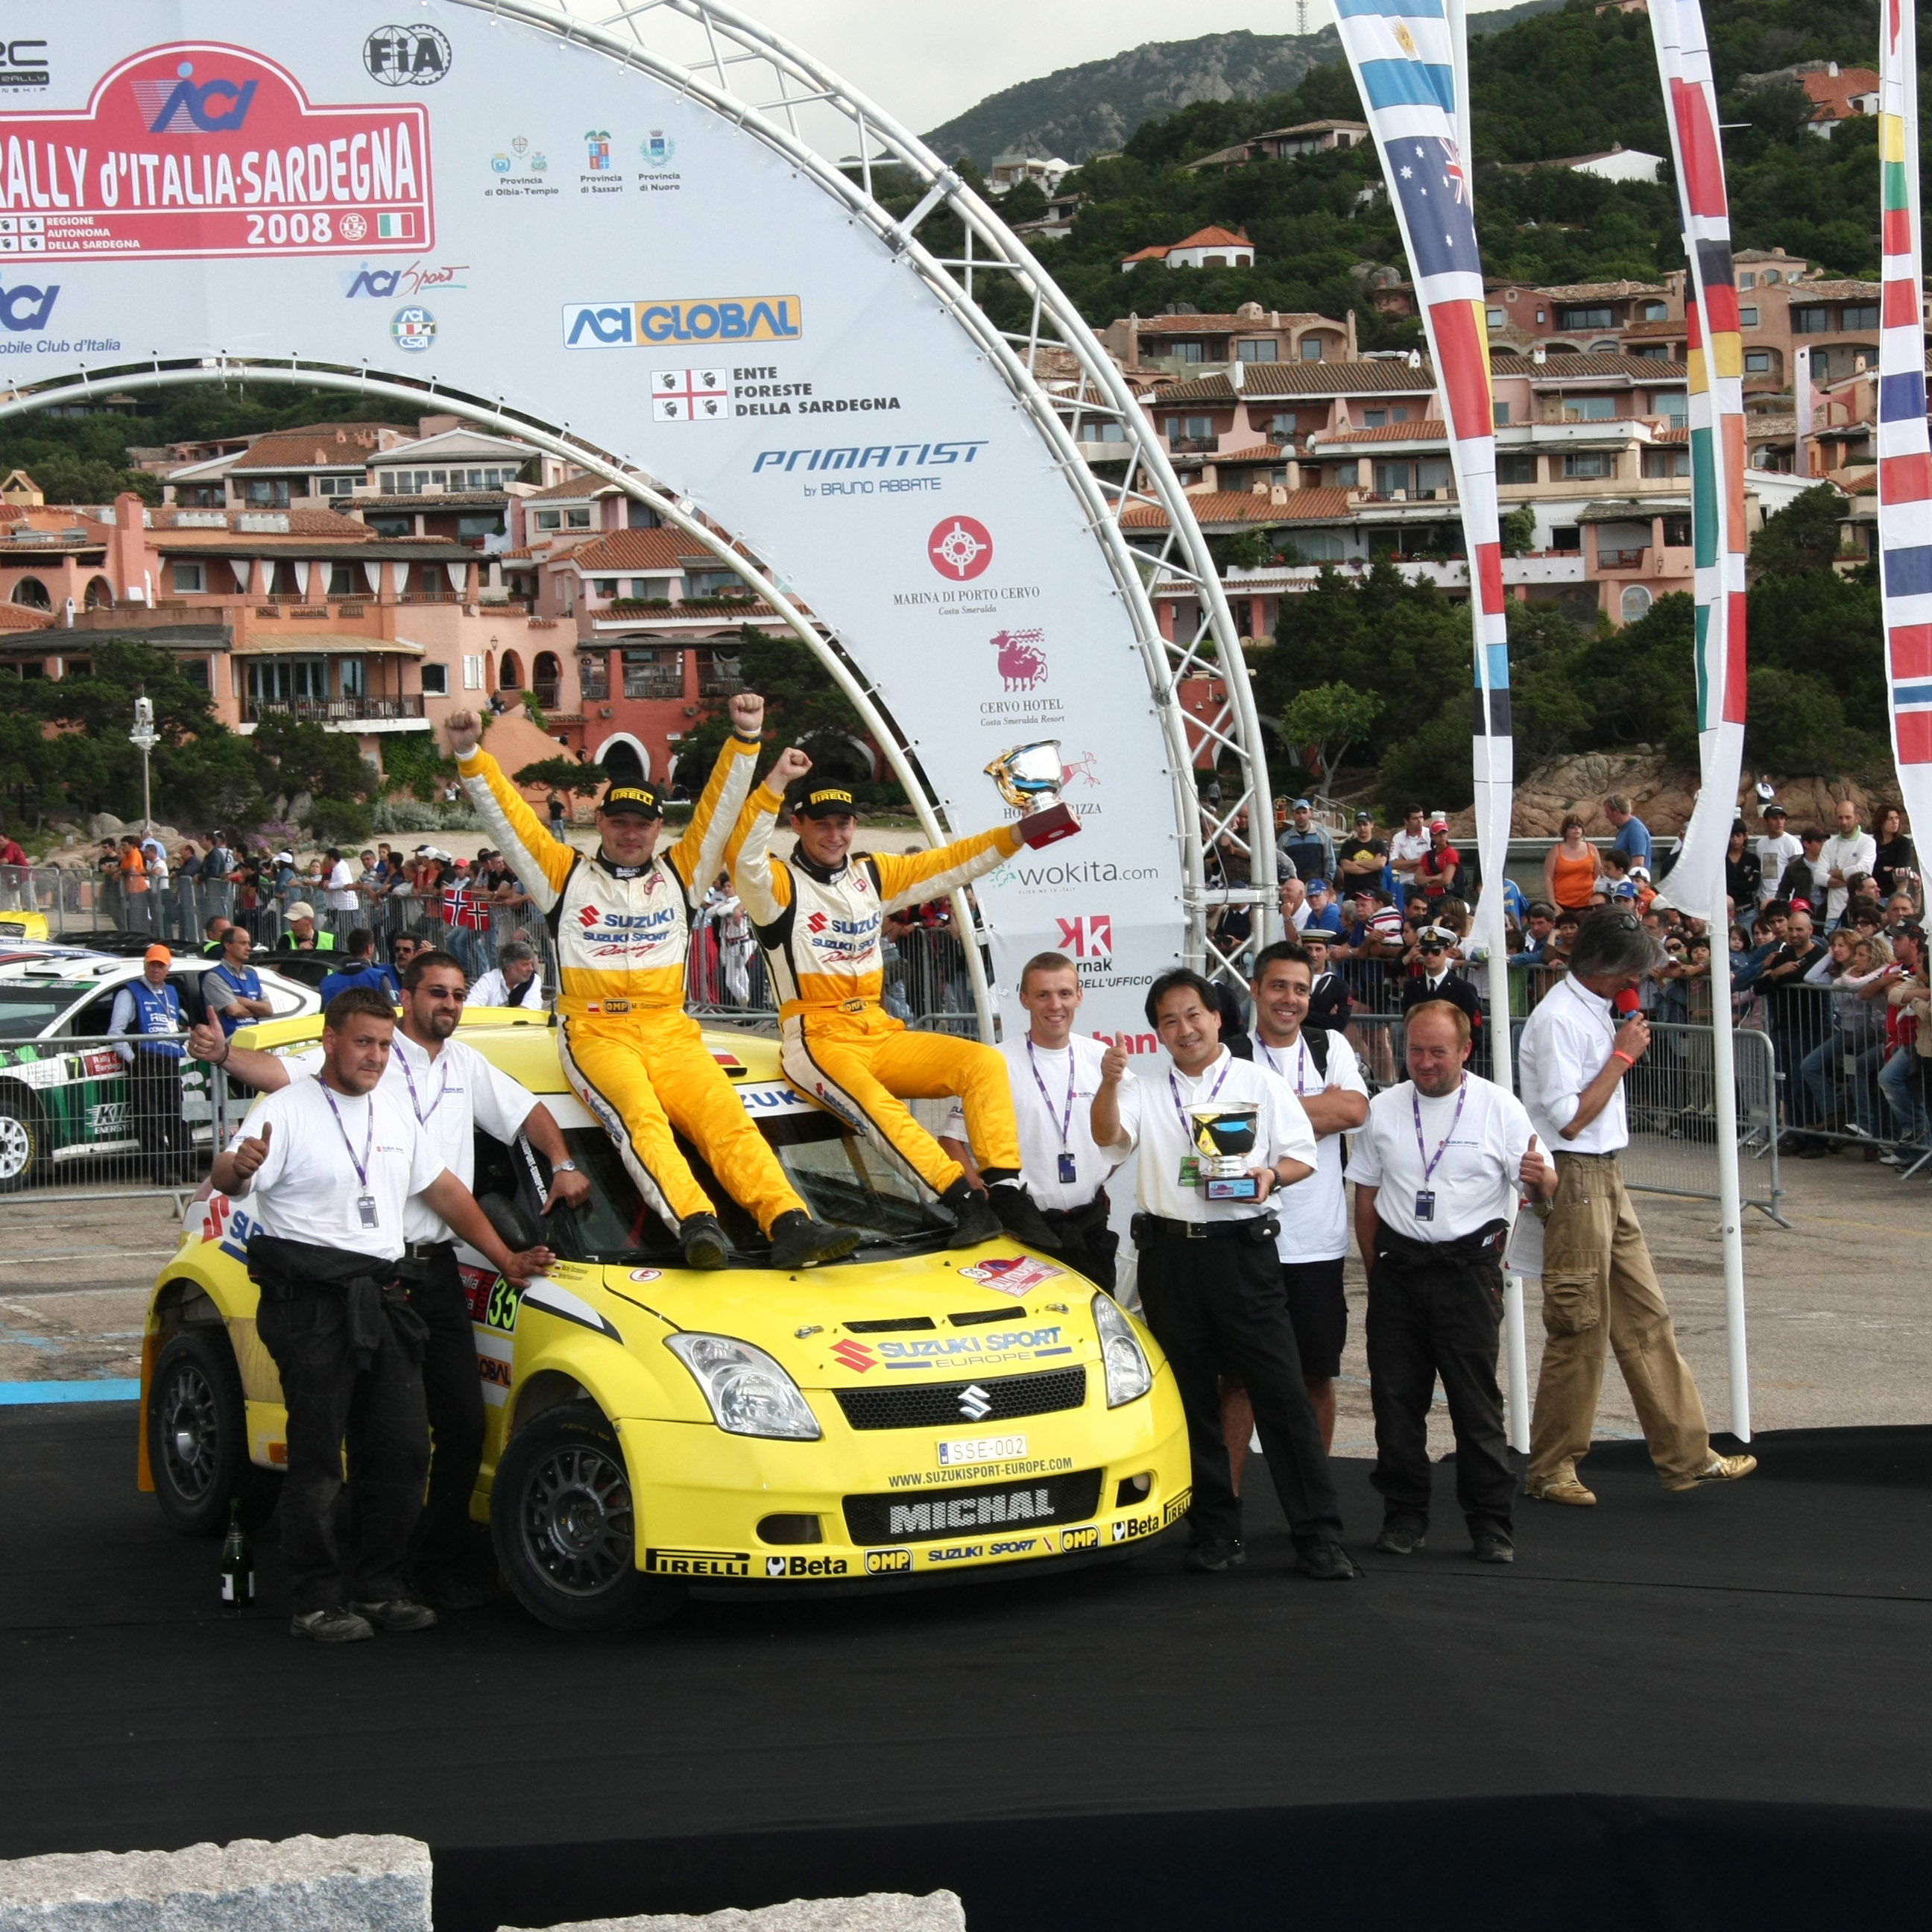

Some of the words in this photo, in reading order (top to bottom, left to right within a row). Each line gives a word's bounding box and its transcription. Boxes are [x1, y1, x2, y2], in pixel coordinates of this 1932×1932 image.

[581, 174, 622, 183] Provincia
[638, 172, 681, 180] Provincia
[484, 188, 493, 196] di
[496, 187, 559, 196] Olbia-Tempio
[592, 185, 623, 194] Sassari
[46, 217, 94, 226] REGIONE
[246, 212, 332, 244] 2008
[47, 228, 111, 238] AUTONOMA
[48, 241, 80, 250] DELLA
[83, 239, 140, 249] SARDEGNA
[346, 270, 402, 298] ACI
[401, 310, 423, 322] ACI
[566, 307, 632, 344] ACI
[640, 300, 799, 341] GLOBAL
[0, 341, 32, 354] obile
[37, 339, 70, 353] Club
[75, 338, 121, 353] d'Italia
[733, 367, 777, 381] ENTE
[734, 382, 812, 399] FORESTE
[735, 401, 791, 417] DELLA
[798, 397, 900, 413] SARDEGNA
[752, 441, 989, 473] PRIMATIST
[804, 484, 817, 497] by
[821, 481, 874, 496] BRUNO
[879, 477, 941, 493] ABBATE
[894, 592, 940, 605] MARINA
[942, 590, 956, 602] DI
[958, 588, 998, 602] PORTO
[1000, 586, 1041, 599] CERVO
[938, 607, 959, 616] Costa
[962, 604, 997, 614] Smeralda
[979, 701, 1020, 714] CERVO
[1023, 698, 1064, 712] HOTEL
[980, 718, 1001, 727] Costa
[1003, 716, 1038, 726] Smeralda
[1041, 715, 1065, 724] Resort
[611, 788, 654, 806] PIRELLI
[1017, 861, 1158, 886] wokita.com
[604, 907, 675, 929] SUZUKI
[583, 932, 629, 943] SUZUKI
[631, 931, 669, 941] SPORT
[586, 941, 667, 958] Racing
[1076, 959, 1112, 973] rnak
[605, 1001, 628, 1013] OMP
[488, 1278, 517, 1330] 35
[877, 1337, 982, 1359] SUZUKI
[985, 1326, 1062, 1350] SPORT
[936, 1351, 1032, 1368] EUROPE
[953, 1438, 1023, 1461] SSE-002
[888, 1457, 1073, 1488] WWW.SUZUKISPORT-EUROPE.COM
[889, 1488, 1055, 1535] MICHAL
[1126, 1514, 1160, 1538] Beta
[1062, 1528, 1098, 1550] OMP
[928, 1545, 984, 1562] SUZUKI
[988, 1538, 1038, 1556] SPORT
[645, 1548, 751, 1576] PIRELLI
[789, 1556, 848, 1576] Beta
[867, 1551, 910, 1572] OMP
